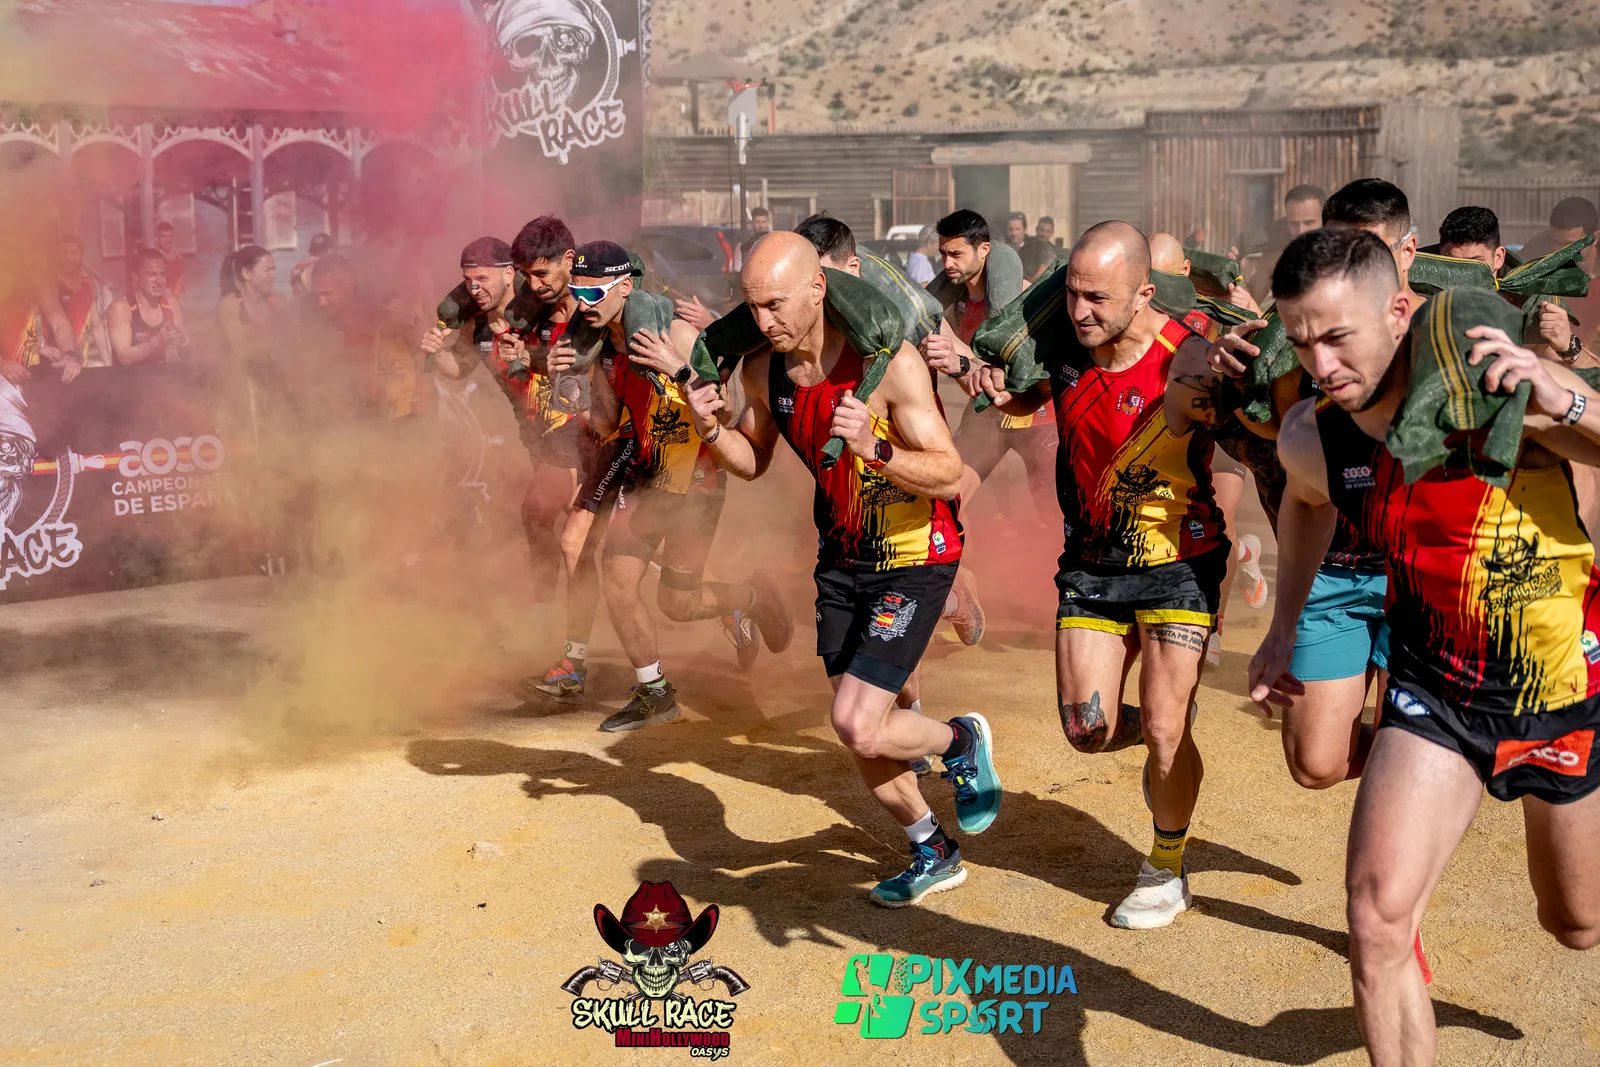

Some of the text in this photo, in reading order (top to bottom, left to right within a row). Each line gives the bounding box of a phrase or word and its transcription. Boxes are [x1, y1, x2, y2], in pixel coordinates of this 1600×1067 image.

[538, 99, 626, 157] RACE
[604, 261, 630, 273] SCOTT
[111, 471, 236, 496] CAMPEONATO
[113, 497, 145, 516] DE
[0, 522, 83, 582] ACE
